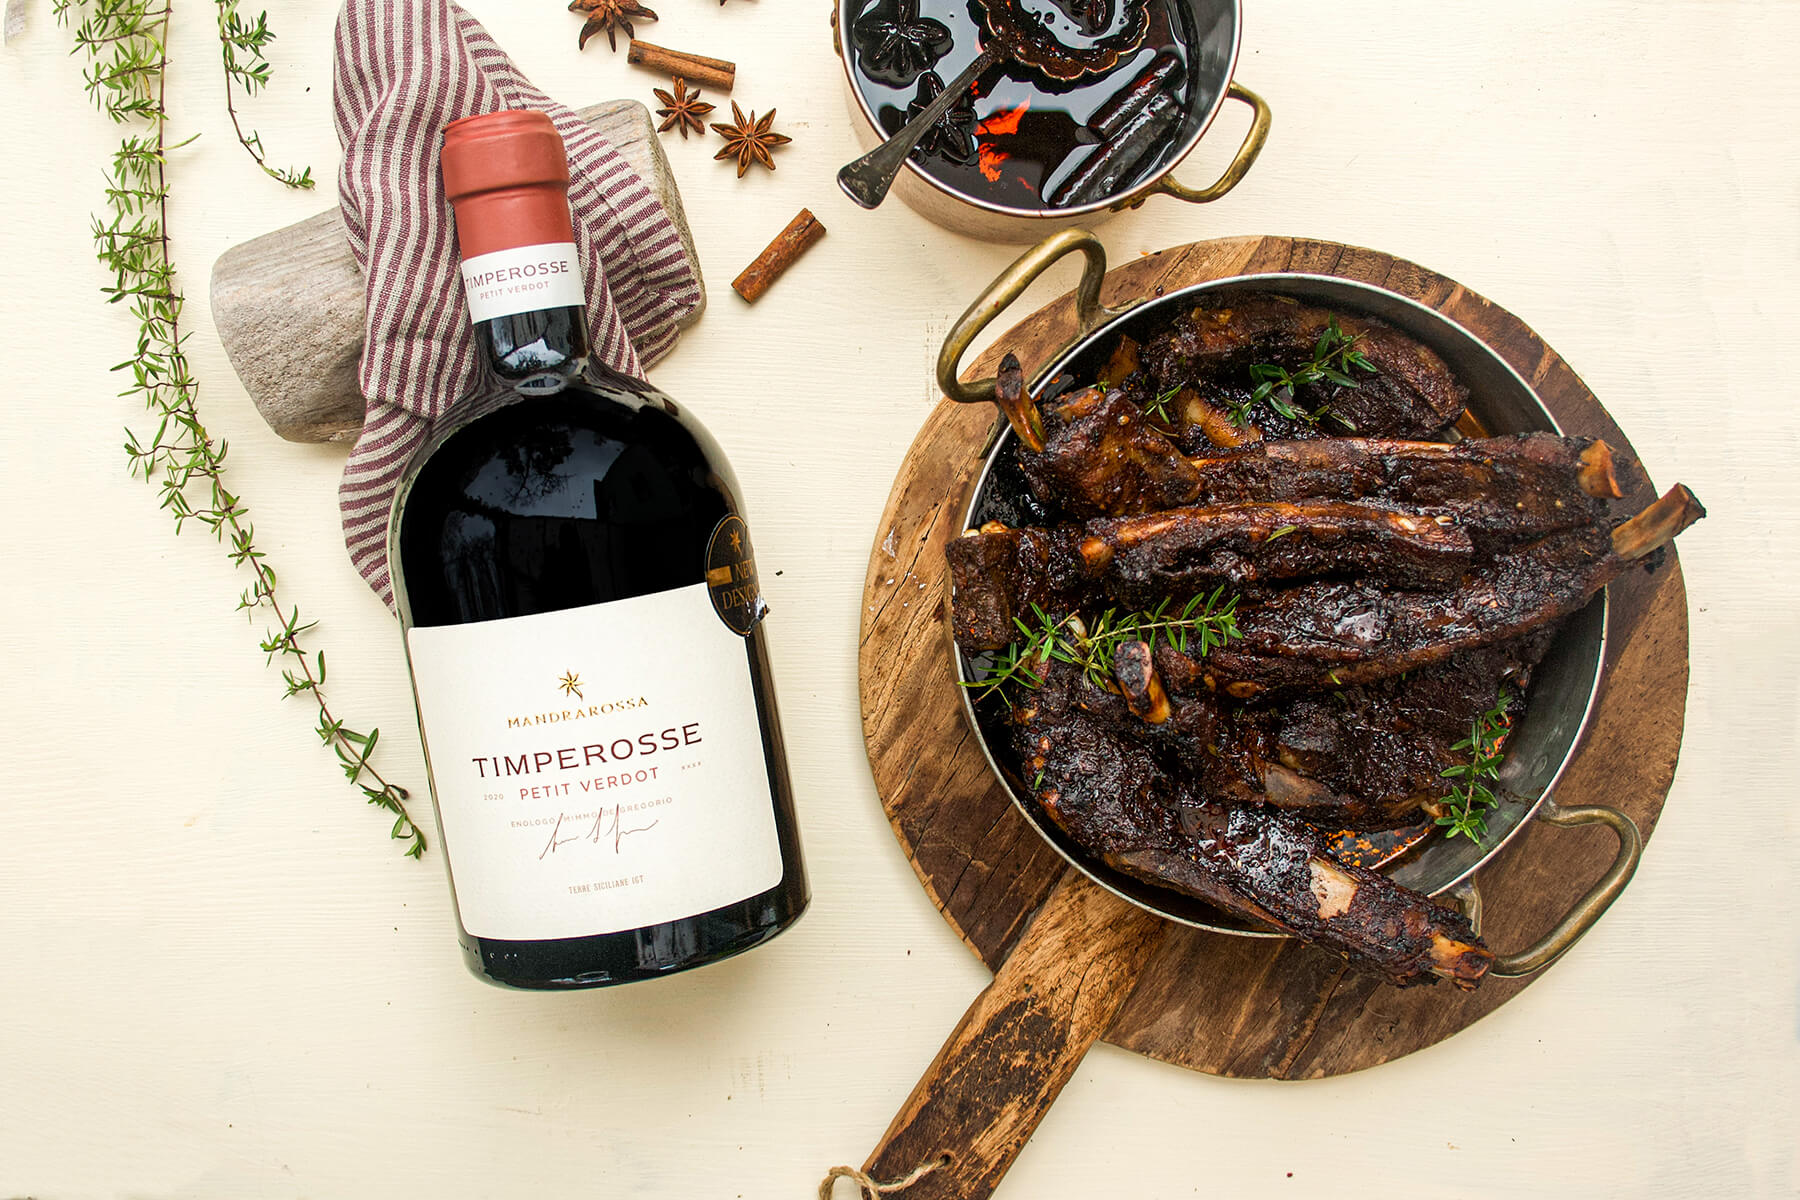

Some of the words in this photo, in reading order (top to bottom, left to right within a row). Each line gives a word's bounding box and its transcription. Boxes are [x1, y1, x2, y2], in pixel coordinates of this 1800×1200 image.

[479, 287, 503, 301] PETIT
[508, 280, 550, 295] VERDOT
[507, 696, 649, 729] MANDRAROSSA
[472, 722, 702, 778] TIMPEROSSE
[483, 792, 504, 801] 2020
[519, 782, 571, 800] PETIT
[580, 766, 659, 793] VERDOT
[511, 816, 556, 828] ENOLOGO
[563, 811, 598, 823] MIMMO
[619, 796, 673, 814] GREGORIO
[568, 885, 590, 895] TERRE
[593, 878, 629, 892] SICILIANE
[631, 874, 645, 885] IGT
